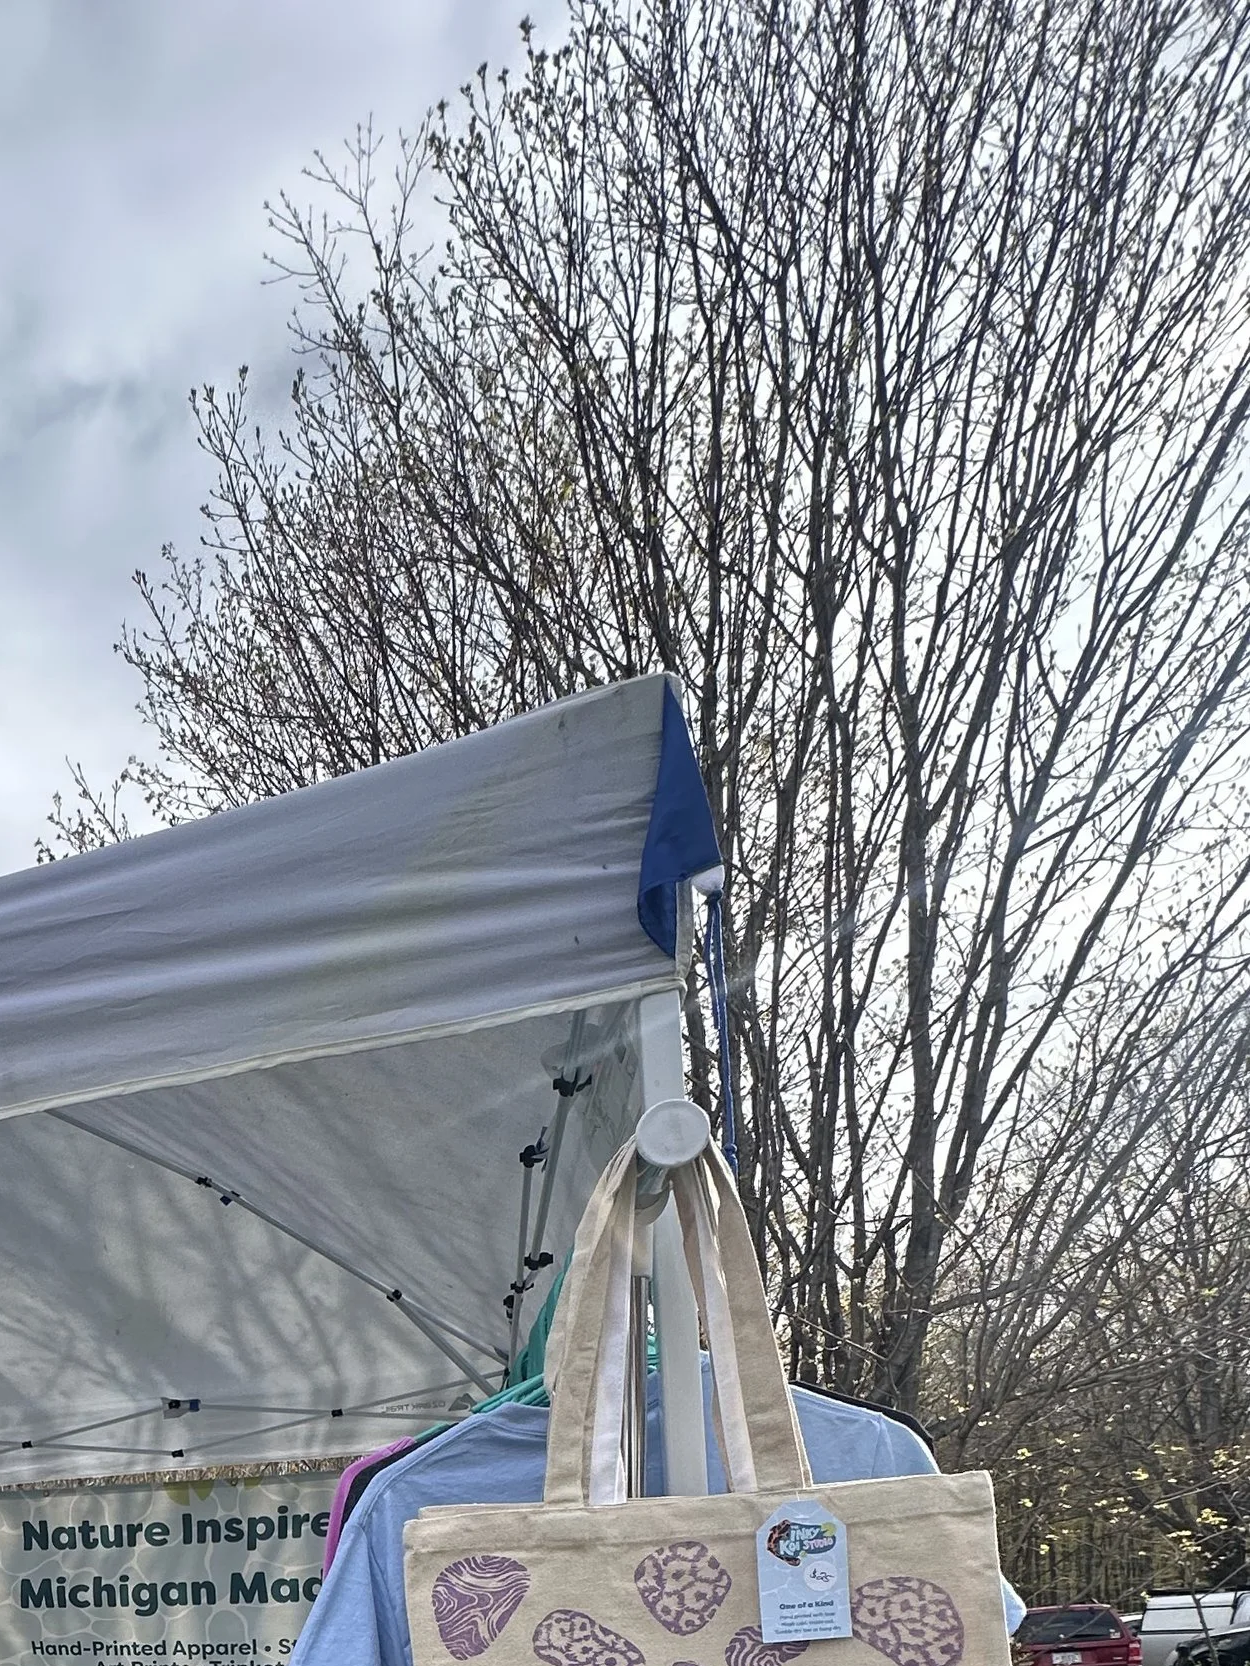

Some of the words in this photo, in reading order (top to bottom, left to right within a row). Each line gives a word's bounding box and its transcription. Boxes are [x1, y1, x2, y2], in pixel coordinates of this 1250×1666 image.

[21, 1519, 170, 1551] Nature
[180, 1504, 331, 1551] Inspire
[20, 1574, 216, 1617] Michigan
[779, 1602, 796, 1610] One
[797, 1601, 806, 1609] of
[814, 1599, 834, 1608] Kind
[31, 1639, 168, 1657] Hand-Printed
[172, 1639, 258, 1660] Apparel
